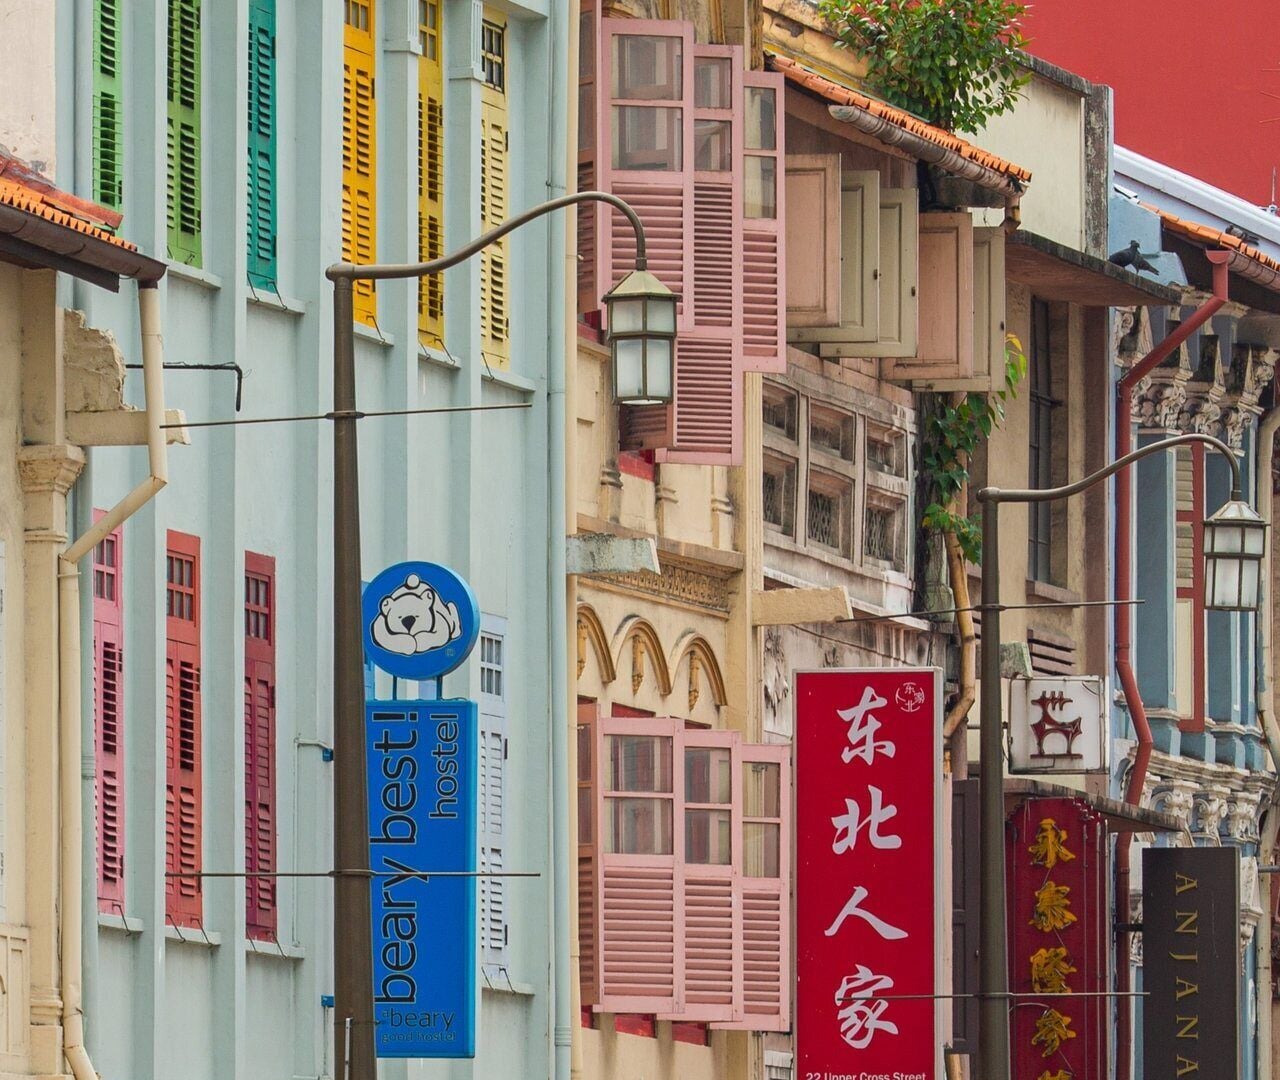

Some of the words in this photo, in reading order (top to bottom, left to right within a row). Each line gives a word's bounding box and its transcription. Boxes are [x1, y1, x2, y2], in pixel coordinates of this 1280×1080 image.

[370, 711, 420, 846] best!
[429, 713, 459, 820] hostel
[374, 855, 429, 1004] beary
[824, 685, 909, 1050] 东北人家
[382, 1032, 413, 1044] good
[418, 1031, 456, 1041] hostel
[390, 1007, 455, 1031] beary
[1175, 871, 1199, 1079] ANJANA
